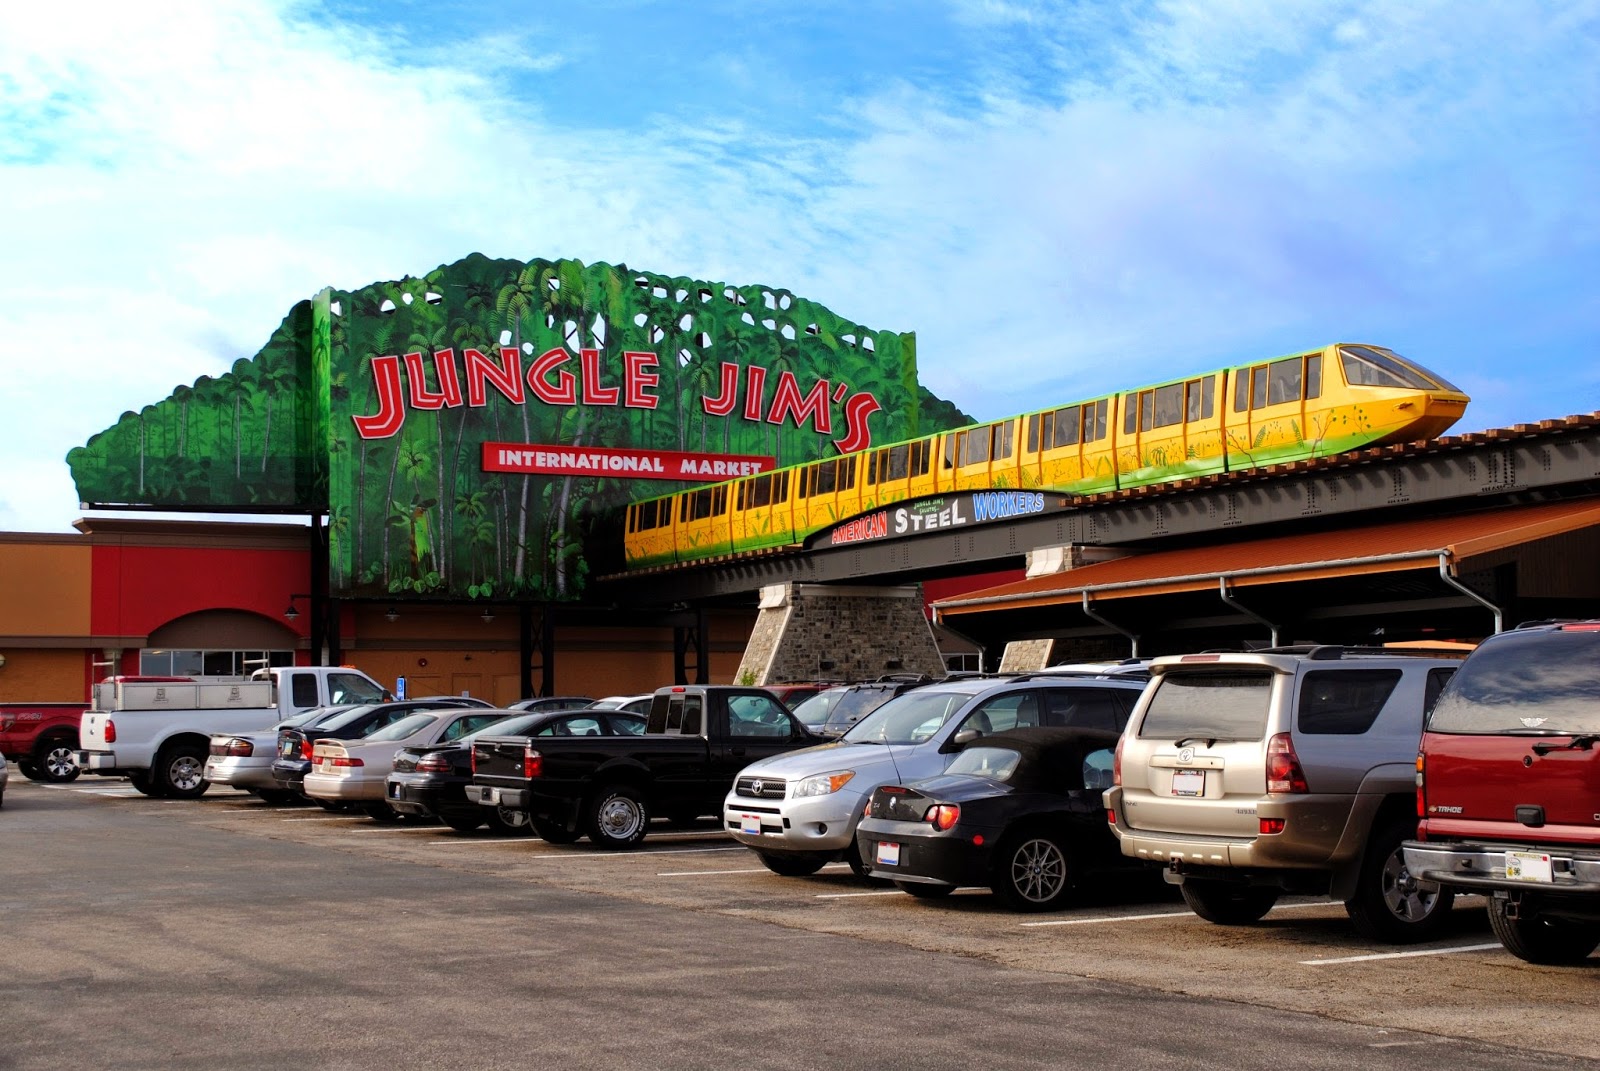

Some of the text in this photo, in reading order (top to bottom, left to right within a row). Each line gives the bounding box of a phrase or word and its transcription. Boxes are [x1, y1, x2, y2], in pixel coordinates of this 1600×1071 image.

[352, 348, 882, 455] JUNGLE JIM'S
[498, 450, 762, 476] INTERNATIONAL MARKET
[831, 492, 1045, 544] AMERICAN STEEL WORKERS
[1438, 805, 1463, 814] TAHOE
